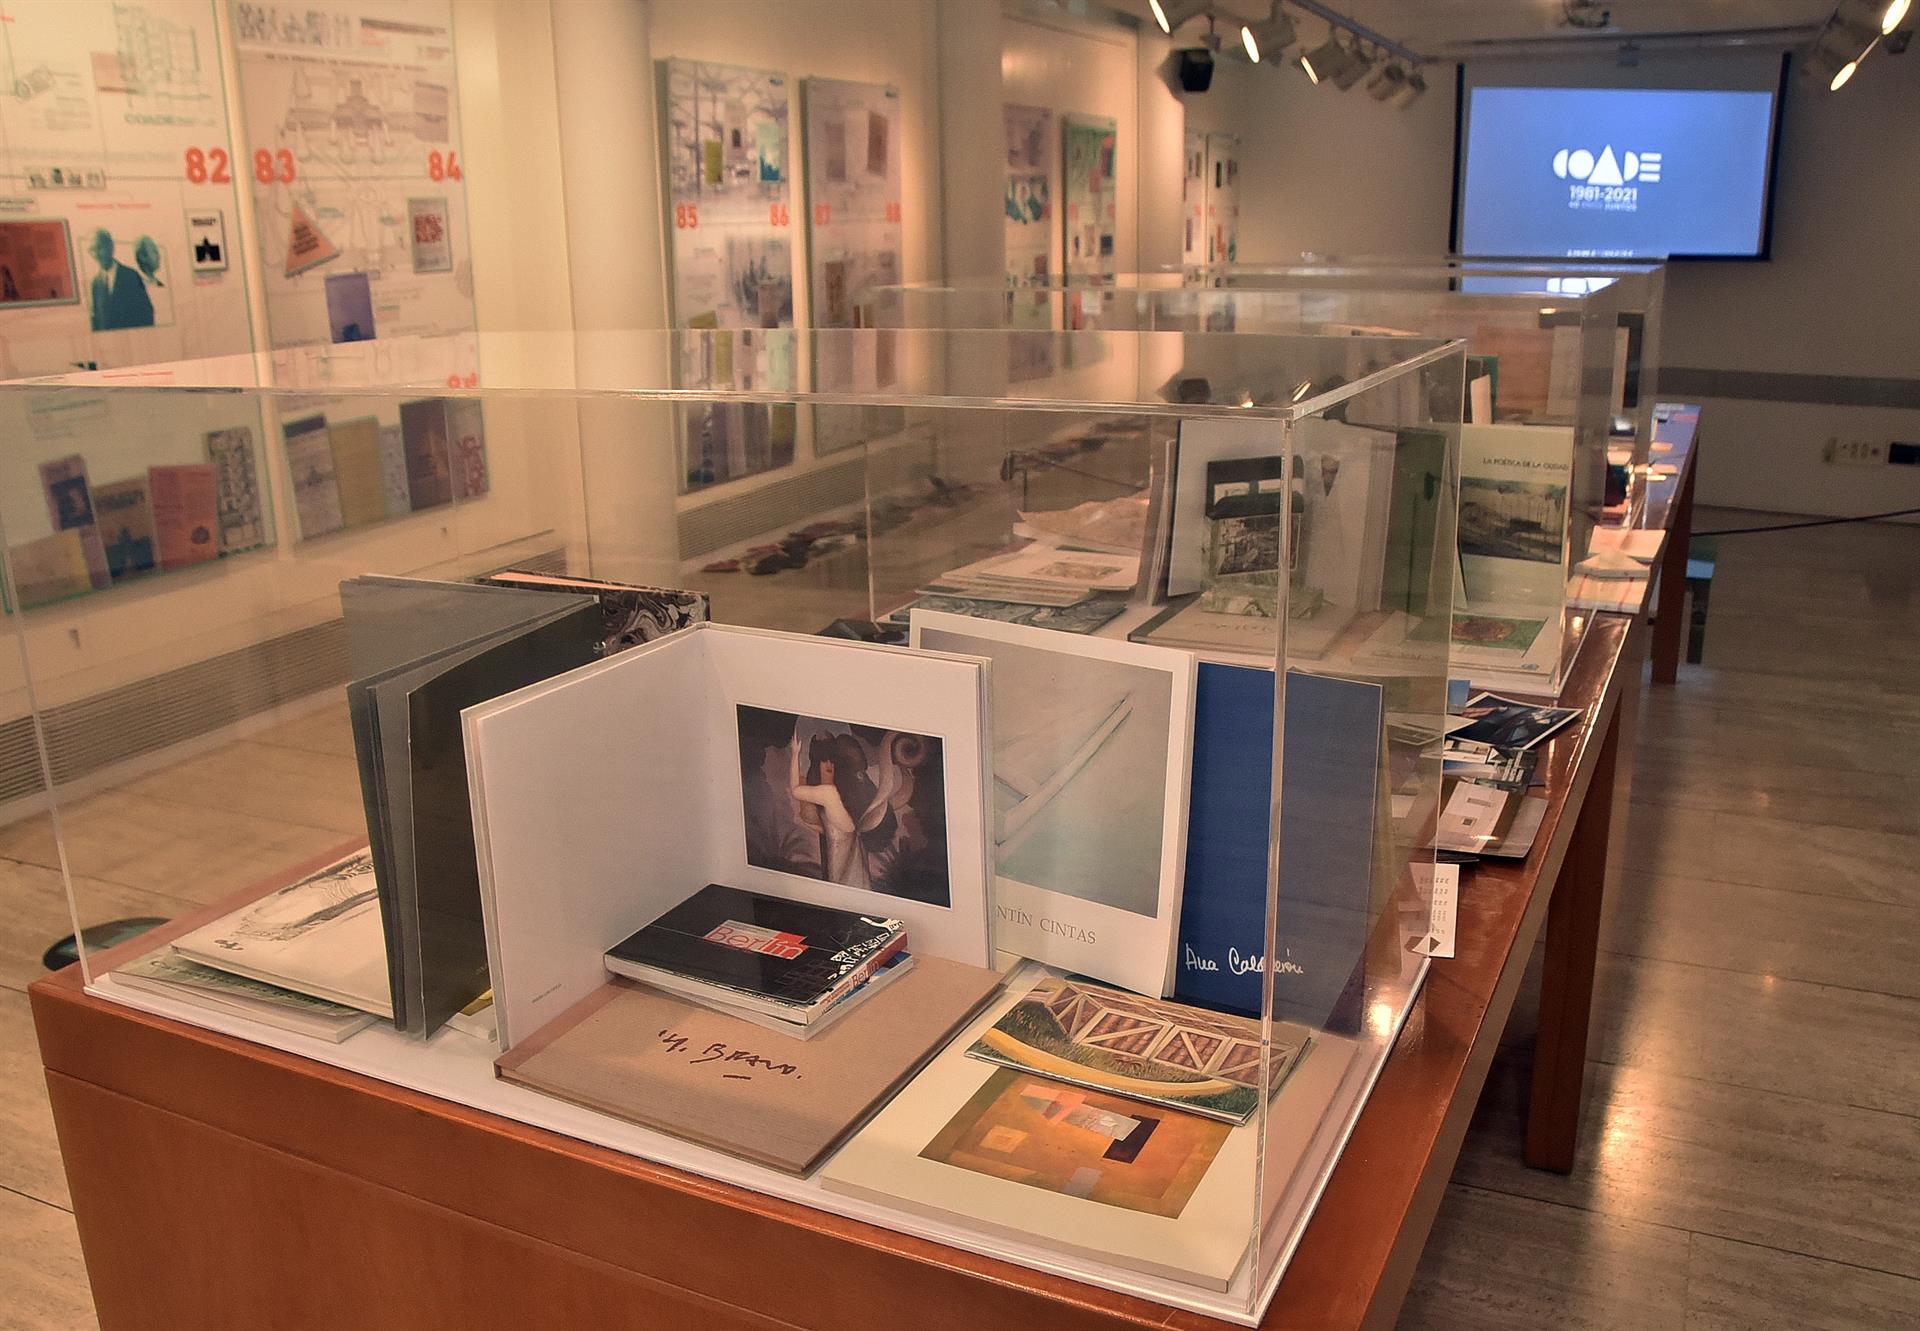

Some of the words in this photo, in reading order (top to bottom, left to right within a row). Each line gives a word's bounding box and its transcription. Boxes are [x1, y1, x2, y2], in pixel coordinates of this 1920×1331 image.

[184, 146, 231, 184] 82
[254, 148, 295, 184] 83
[428, 149, 462, 183] 84
[1569, 185, 1638, 202] 1981-2021
[676, 203, 698, 228] 85
[770, 203, 789, 226] 86
[996, 904, 1032, 927] NTÍN
[1040, 918, 1096, 944] CINTAS
[704, 926, 805, 960] Berlin
